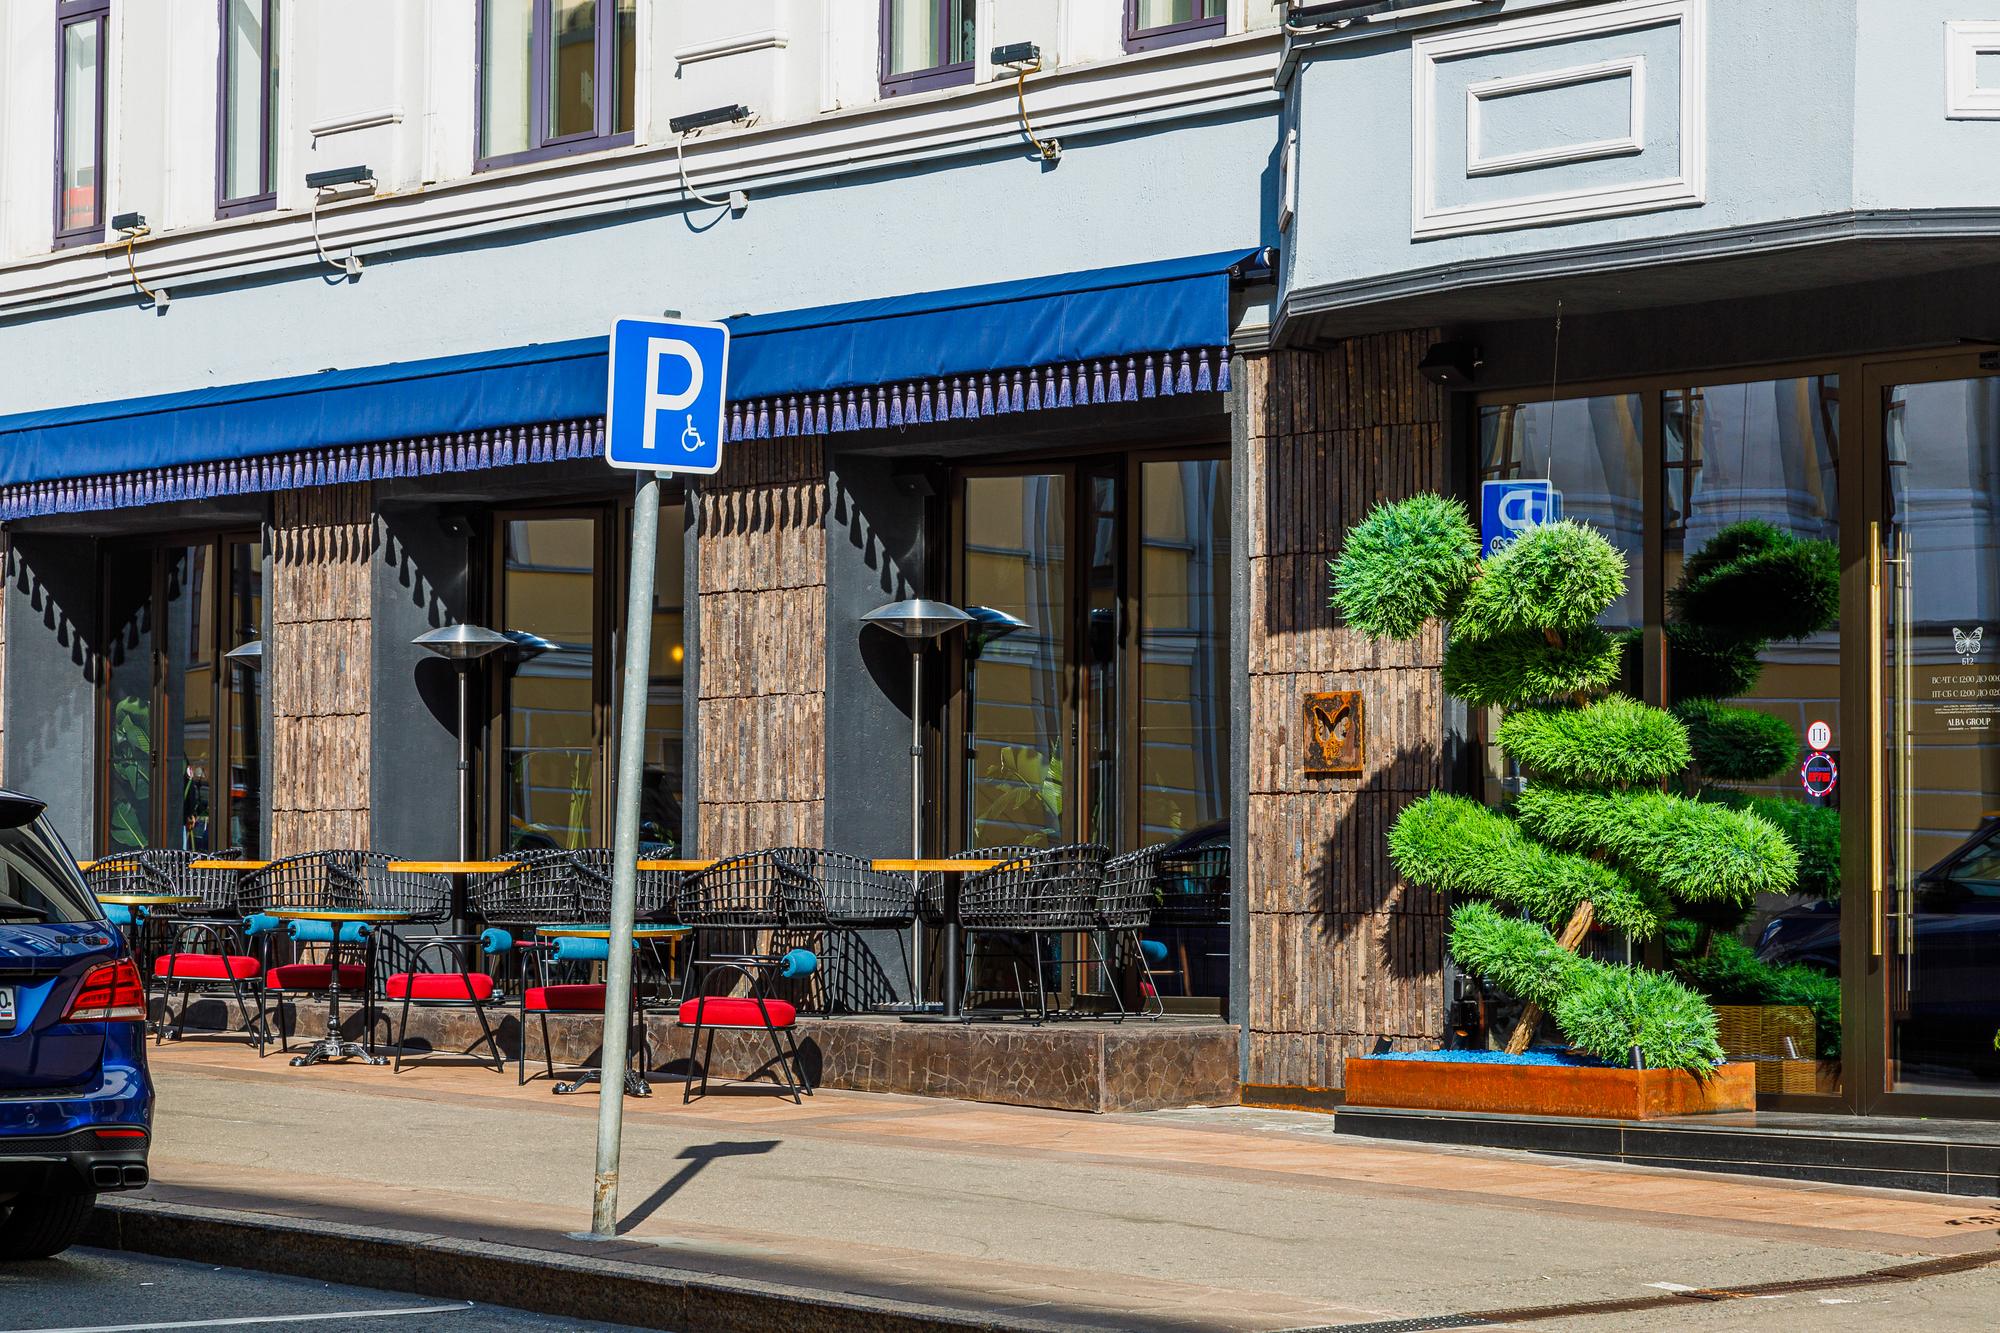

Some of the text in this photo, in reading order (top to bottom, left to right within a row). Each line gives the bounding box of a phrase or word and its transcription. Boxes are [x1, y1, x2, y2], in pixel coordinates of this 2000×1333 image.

[643, 337, 704, 449] P
[1976, 675, 1987, 684] ДО
[1932, 690, 1952, 698] ПТ-СБ
[1976, 689, 1988, 698] ДО
[1947, 717, 1991, 726] ALBA GROUP
